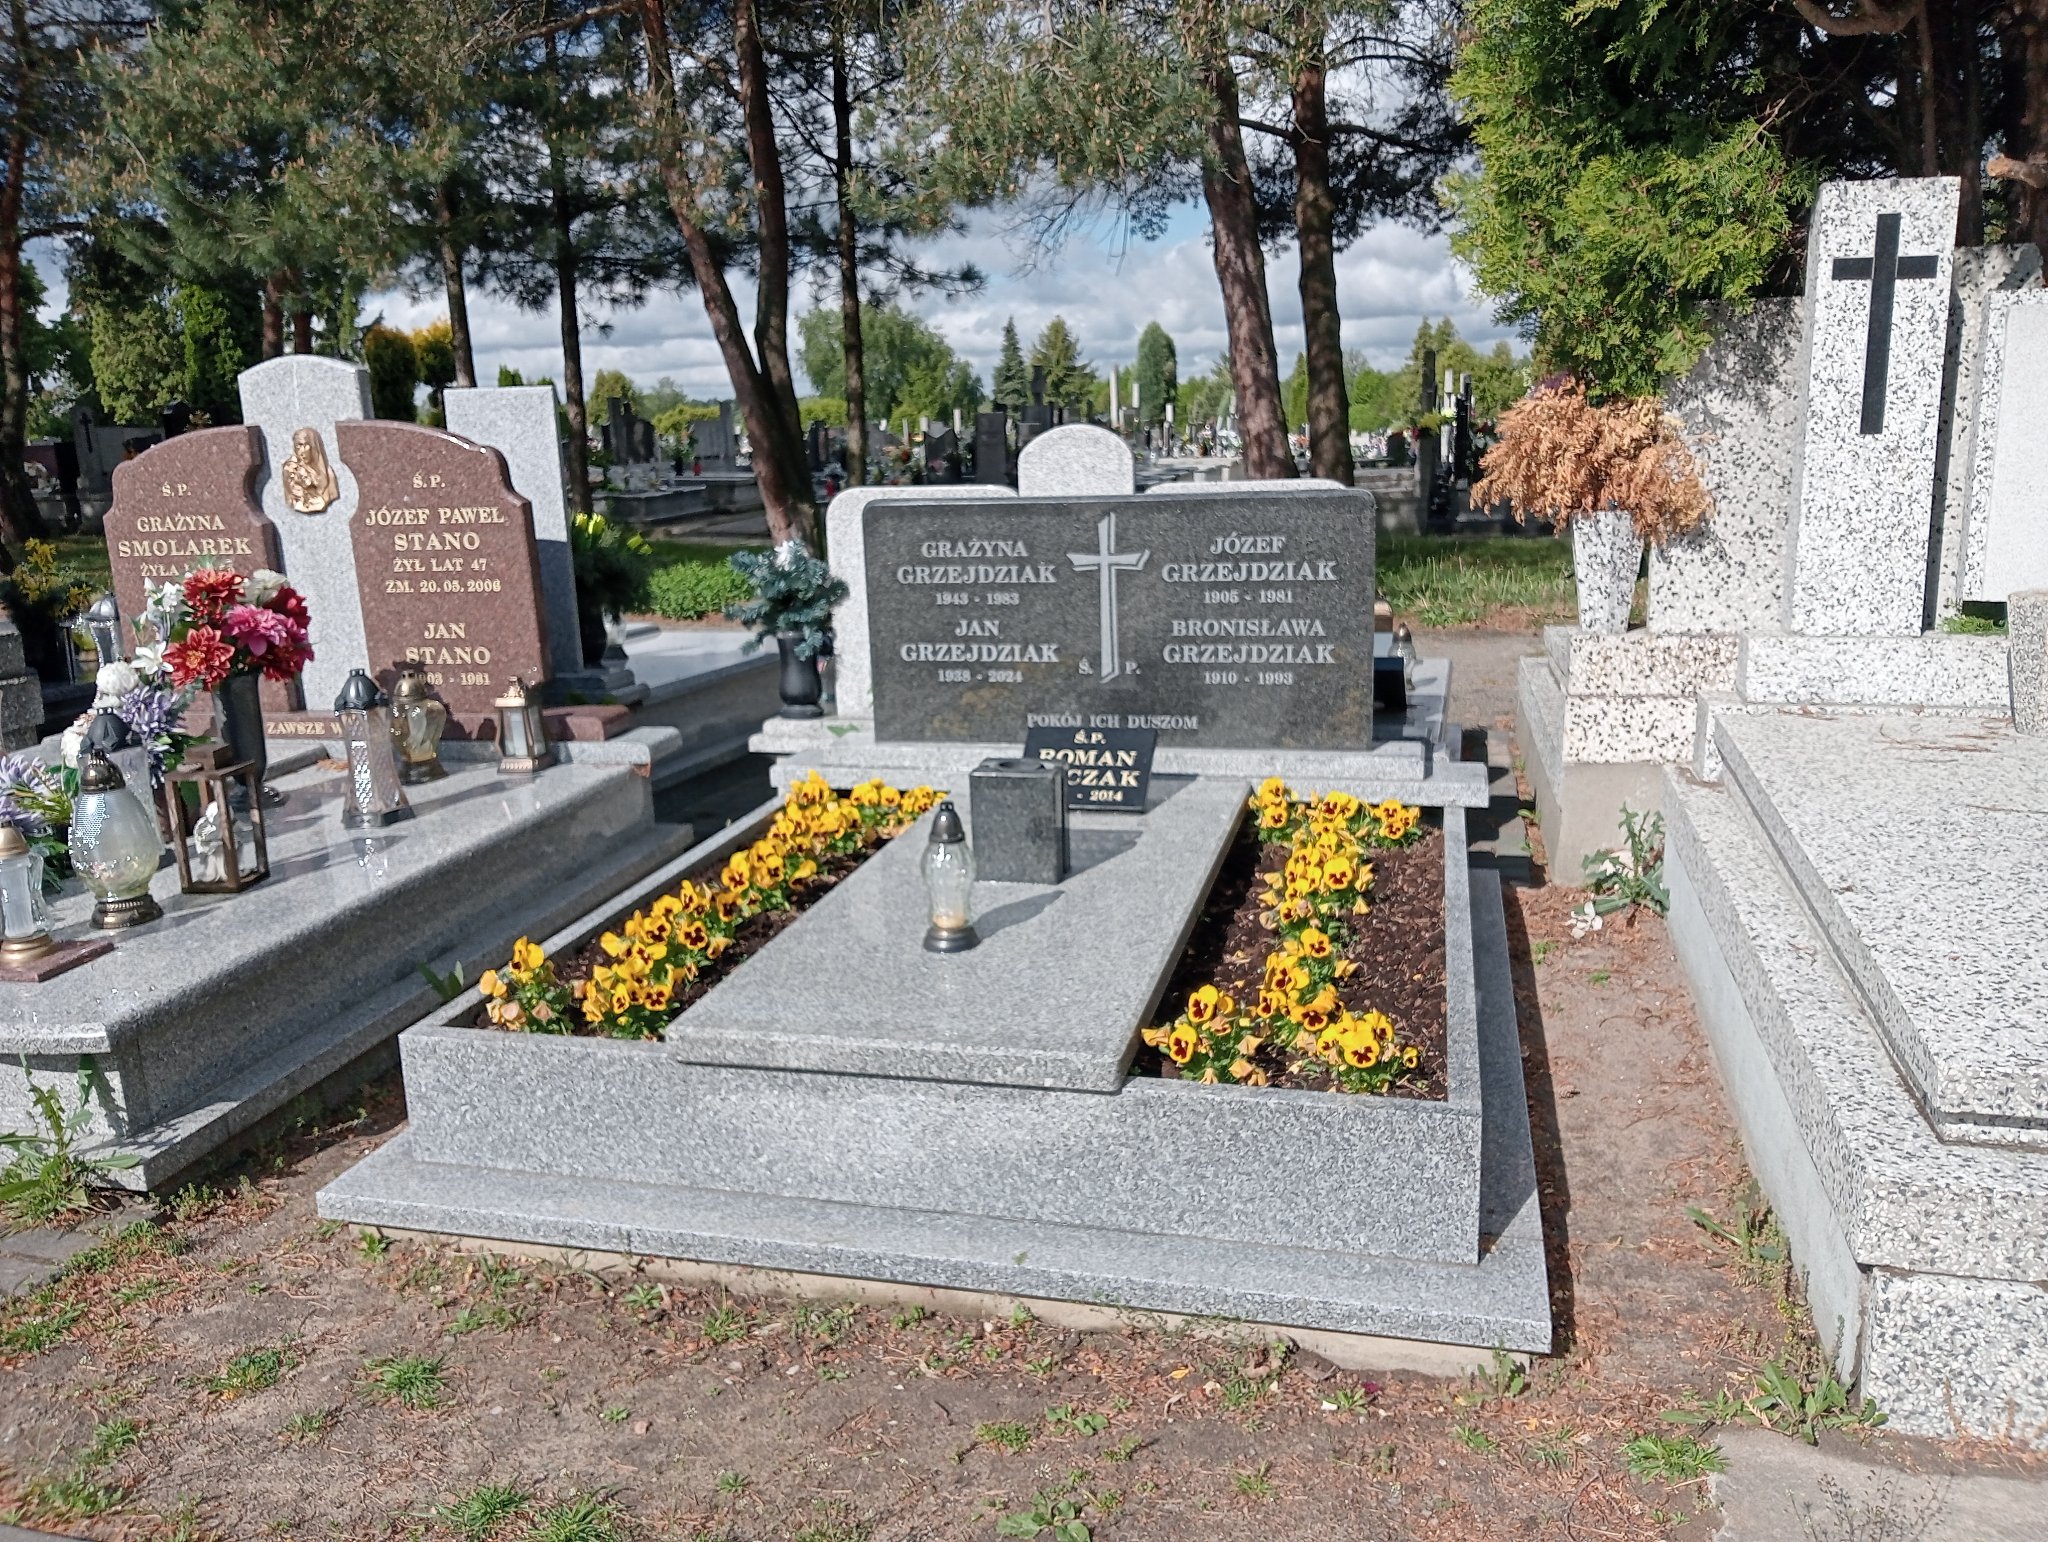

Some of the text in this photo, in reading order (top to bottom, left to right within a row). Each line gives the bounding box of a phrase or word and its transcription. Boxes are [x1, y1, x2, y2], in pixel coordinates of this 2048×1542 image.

[137, 512, 226, 533] GRAŻYNA
[365, 505, 430, 526] JÓZEF
[118, 537, 253, 557] SMOLAREK
[393, 531, 480, 552] STANO
[921, 537, 1029, 558] GRAŻYNA
[1209, 530, 1286, 555] JÓZEF
[393, 556, 488, 572] ŻYŁ LAT 47
[1161, 560, 1338, 583] GRZEJDZIAK
[896, 564, 1058, 584] GRZEJDZIAK
[385, 580, 414, 594] ZM.
[1203, 589, 1240, 604] 1905
[424, 622, 466, 639] JAN
[954, 620, 1000, 636] JAN
[1171, 618, 1327, 637] BRONISŁAWA
[405, 646, 491, 665] STANO
[901, 643, 1060, 663] GRZEJDZIAK
[1162, 643, 1336, 664] GRZEJDZIAK
[988, 669, 1024, 683] 2024
[1125, 660, 1141, 675] P.
[1203, 671, 1238, 685] 1910
[1257, 671, 1294, 686] 1993
[266, 721, 326, 735] ZAWSZE
[1026, 711, 1199, 730] POKÓJ ICH DUSZOM
[1039, 748, 1137, 767] ROMAN
[1066, 769, 1142, 788] CZAK
[1088, 790, 1124, 802] 2014
